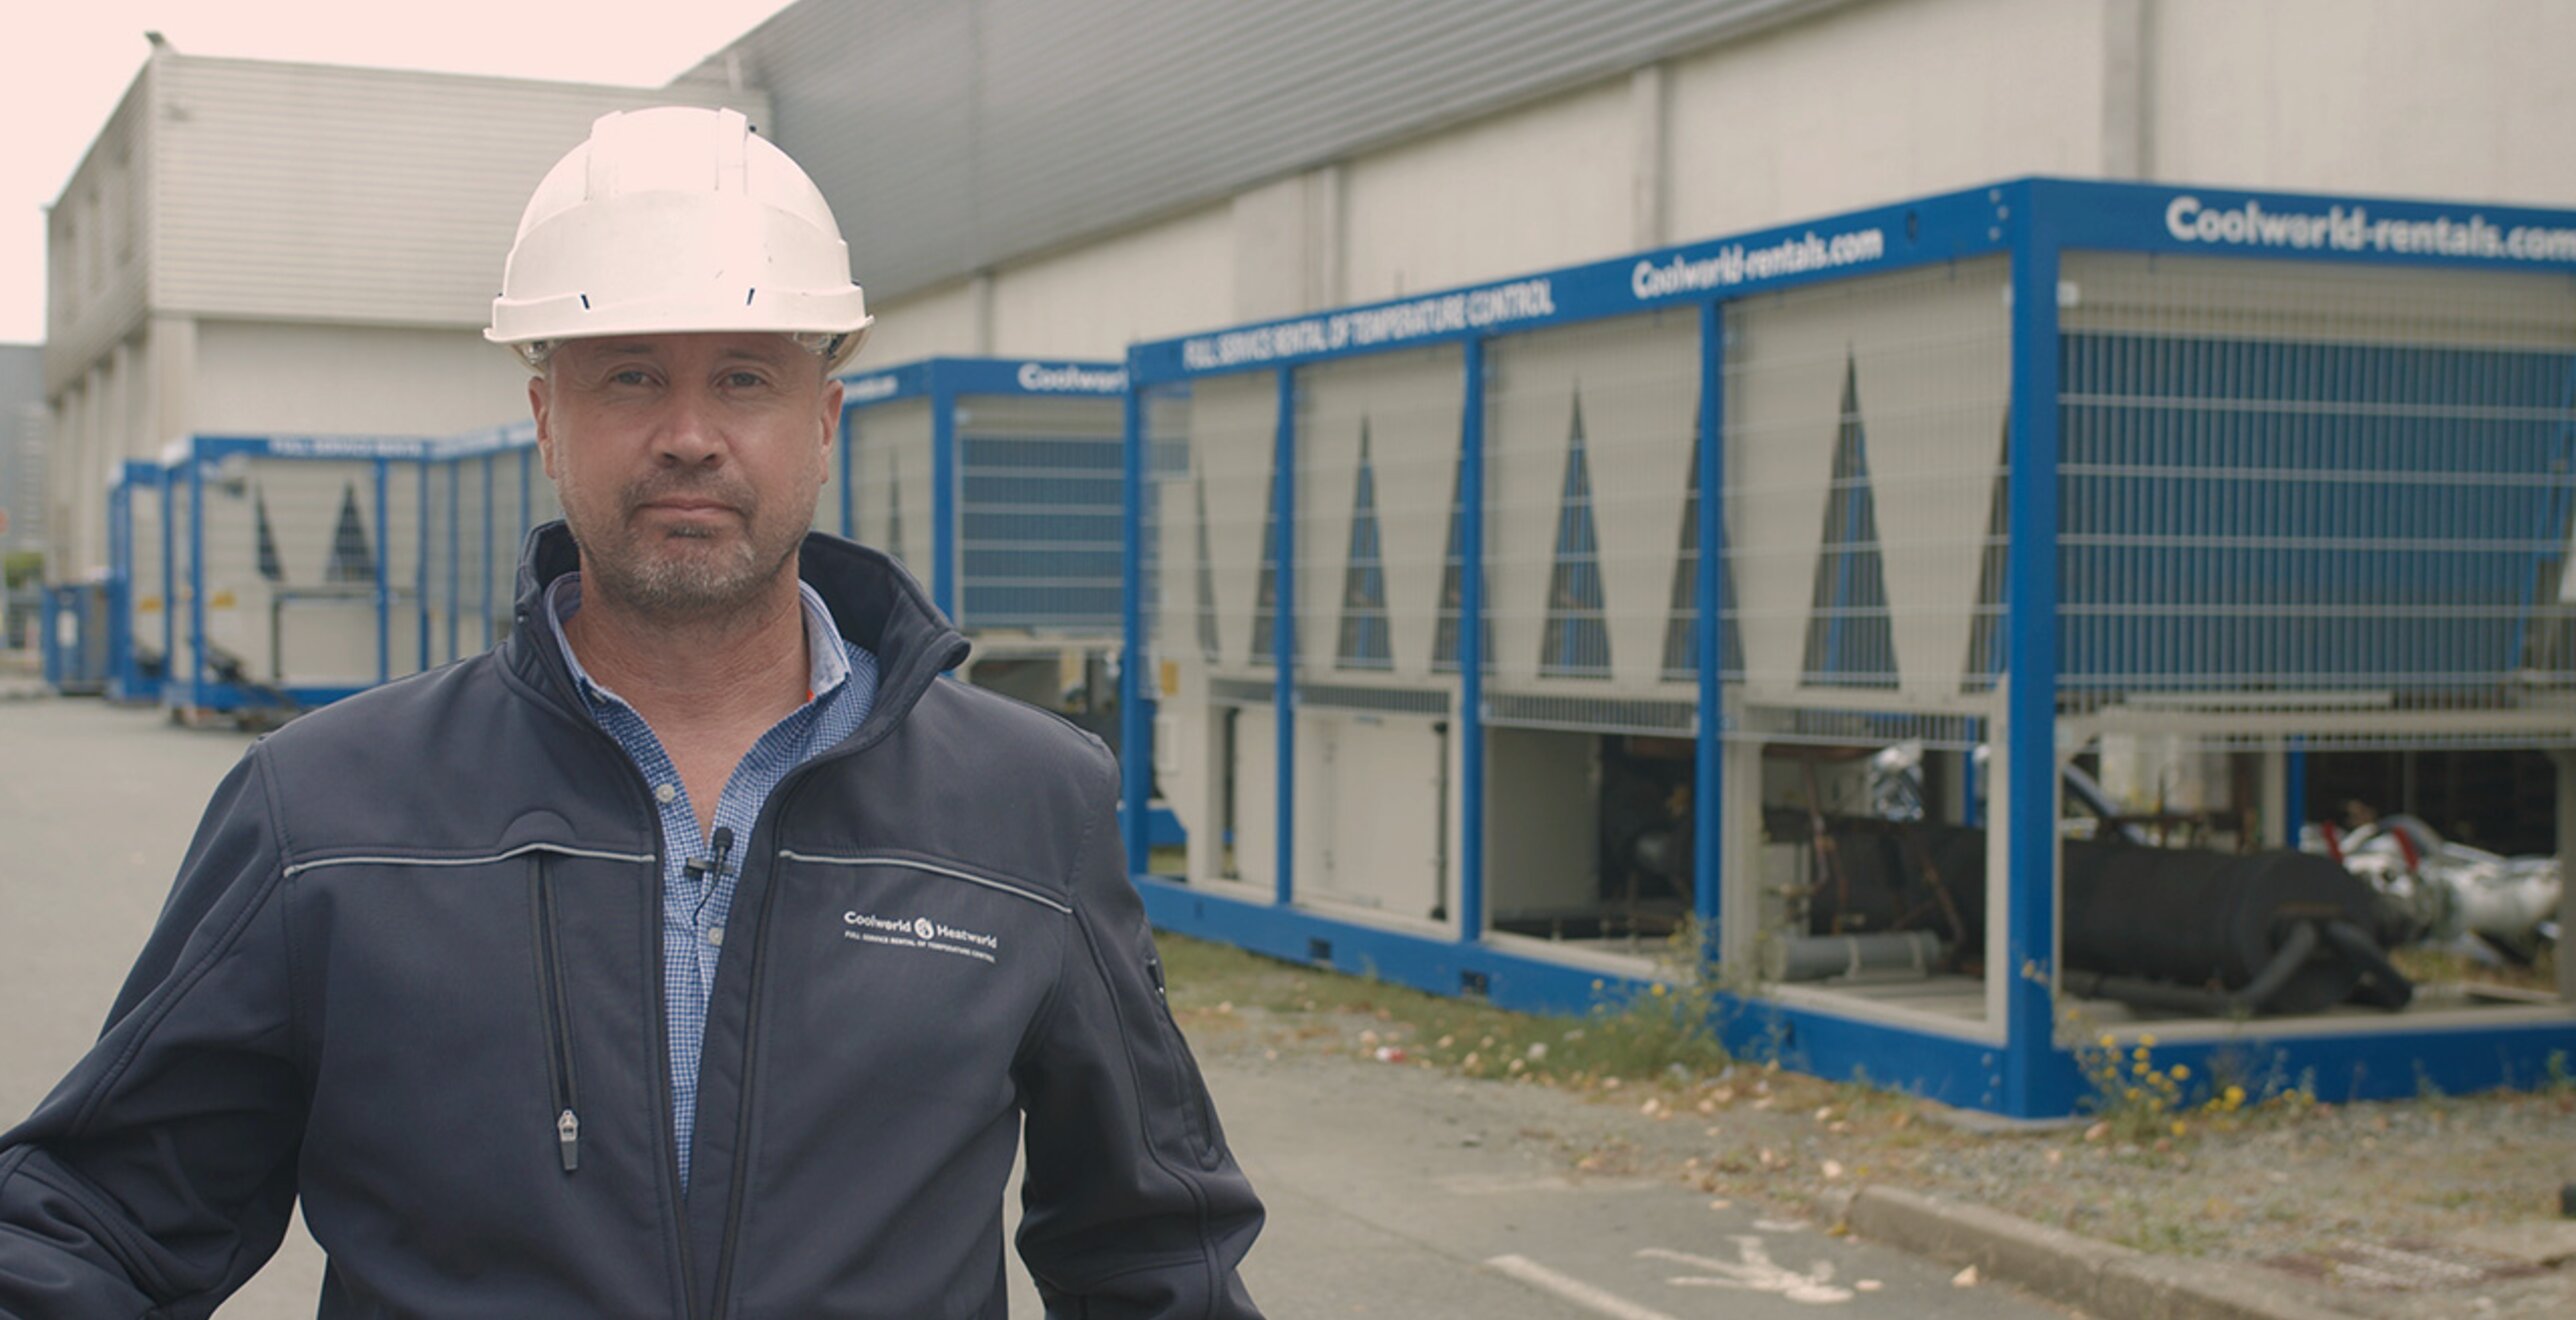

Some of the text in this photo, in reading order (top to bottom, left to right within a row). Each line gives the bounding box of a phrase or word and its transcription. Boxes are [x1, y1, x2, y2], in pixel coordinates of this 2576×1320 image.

[2165, 196, 2576, 262] Coolworld-rentals.com
[1633, 228, 1883, 299] Coolworld-rentals.com
[1467, 278, 1556, 327] CONTROL
[844, 911, 997, 948] Coolworld Heatworld
